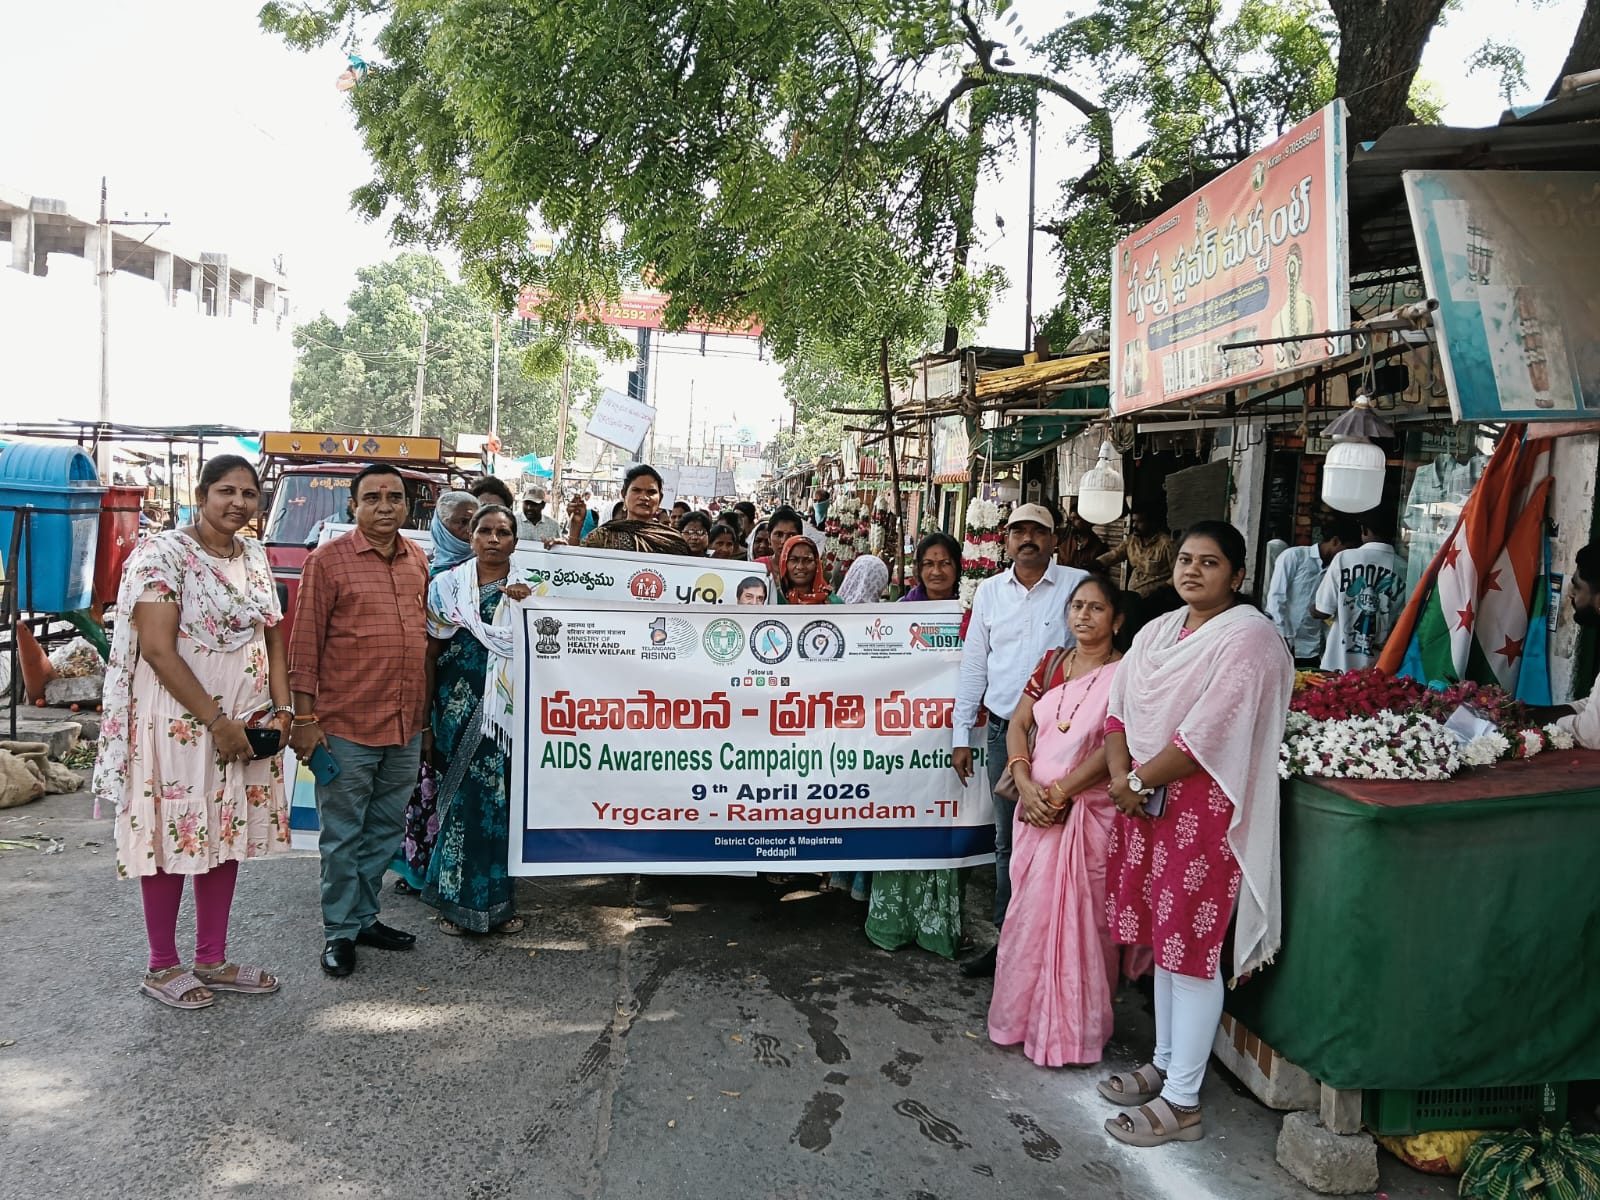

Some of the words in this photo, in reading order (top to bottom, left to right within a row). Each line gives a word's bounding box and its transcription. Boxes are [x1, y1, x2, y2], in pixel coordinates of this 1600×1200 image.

[552, 568, 614, 591] ప్రభుత్వము
[930, 635, 959, 647] 1097
[641, 651, 676, 660] RISING
[747, 668, 765, 676] Follow
[541, 690, 731, 737] ప్రజాపాలన
[769, 691, 866, 737] ప్రగతి
[540, 741, 591, 770] AIDS
[598, 743, 713, 772] Awareness
[719, 742, 823, 778] Campaign
[830, 741, 857, 778] (99
[863, 749, 904, 775] Days
[909, 748, 953, 769] Actio
[691, 783, 707, 800] 9
[712, 783, 728, 794] th
[736, 783, 798, 802] April
[807, 783, 870, 799] 2026
[592, 801, 699, 826] Yrgcare
[727, 801, 916, 823] Ramagundam
[714, 837, 746, 845] District
[748, 837, 787, 845] Collector
[789, 837, 796, 845] &
[798, 836, 843, 846] Magistrate
